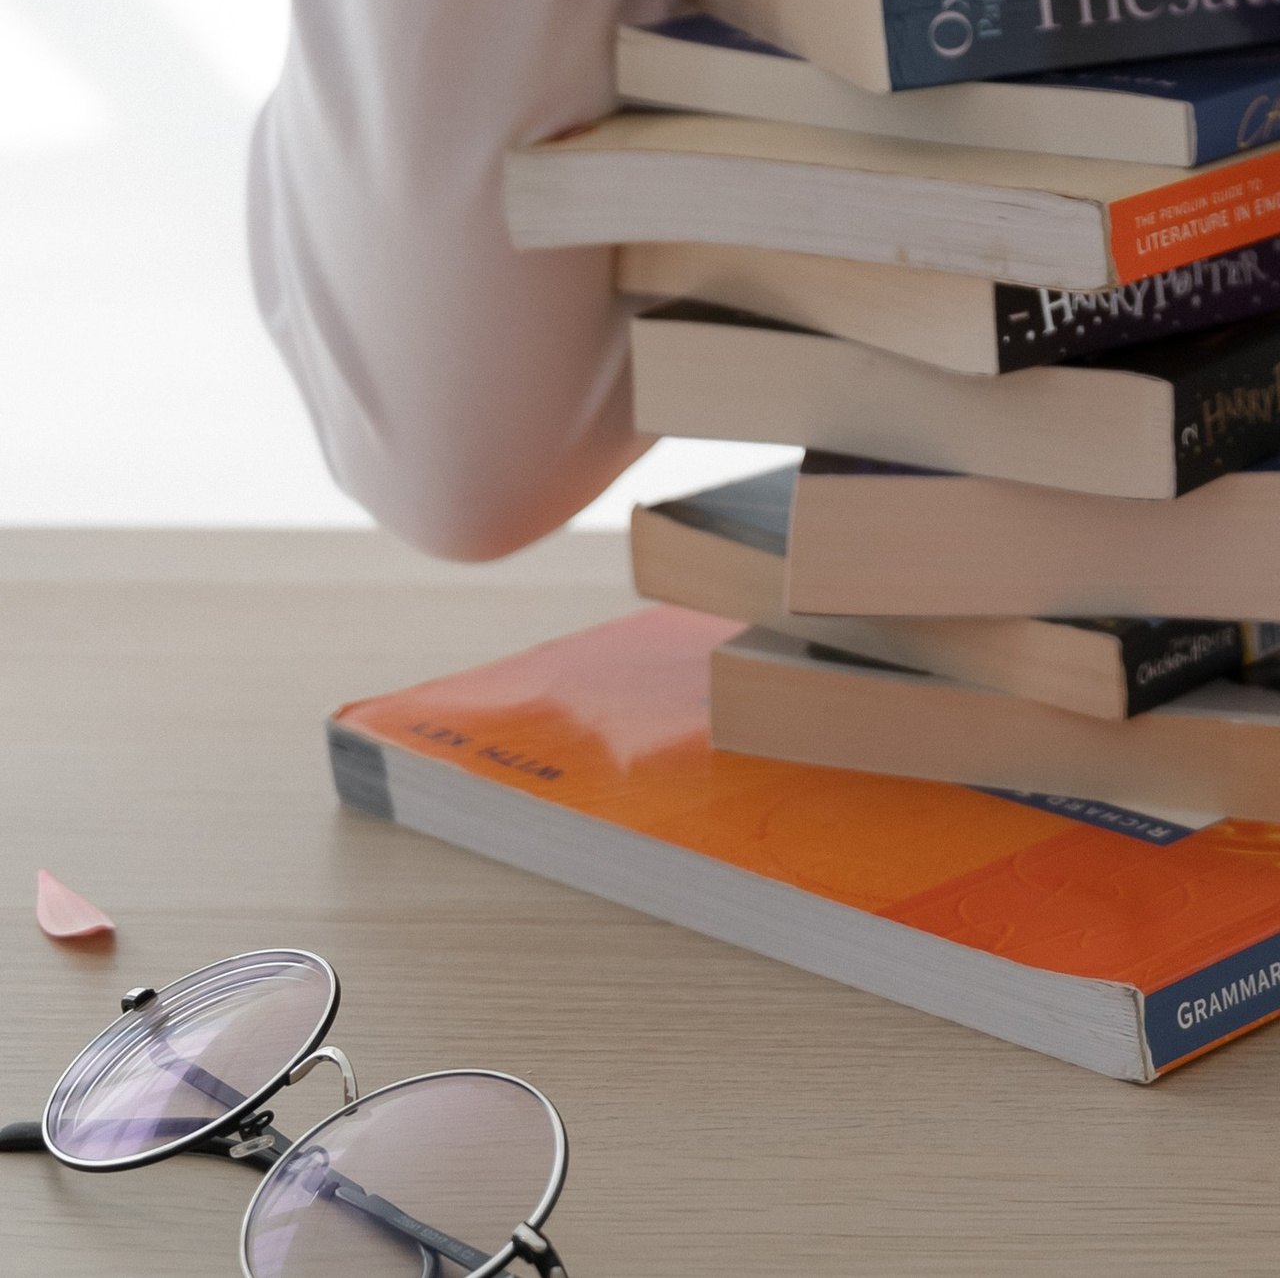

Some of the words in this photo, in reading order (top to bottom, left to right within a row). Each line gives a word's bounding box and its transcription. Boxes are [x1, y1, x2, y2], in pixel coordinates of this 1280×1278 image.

[1134, 208, 1157, 230] THE
[1158, 196, 1209, 223] PENGUIN
[1211, 185, 1245, 206] GUIDE
[1135, 211, 1230, 256] LITERATURE
[1232, 203, 1252, 224] IN
[1045, 794, 1173, 838] RICHARD
